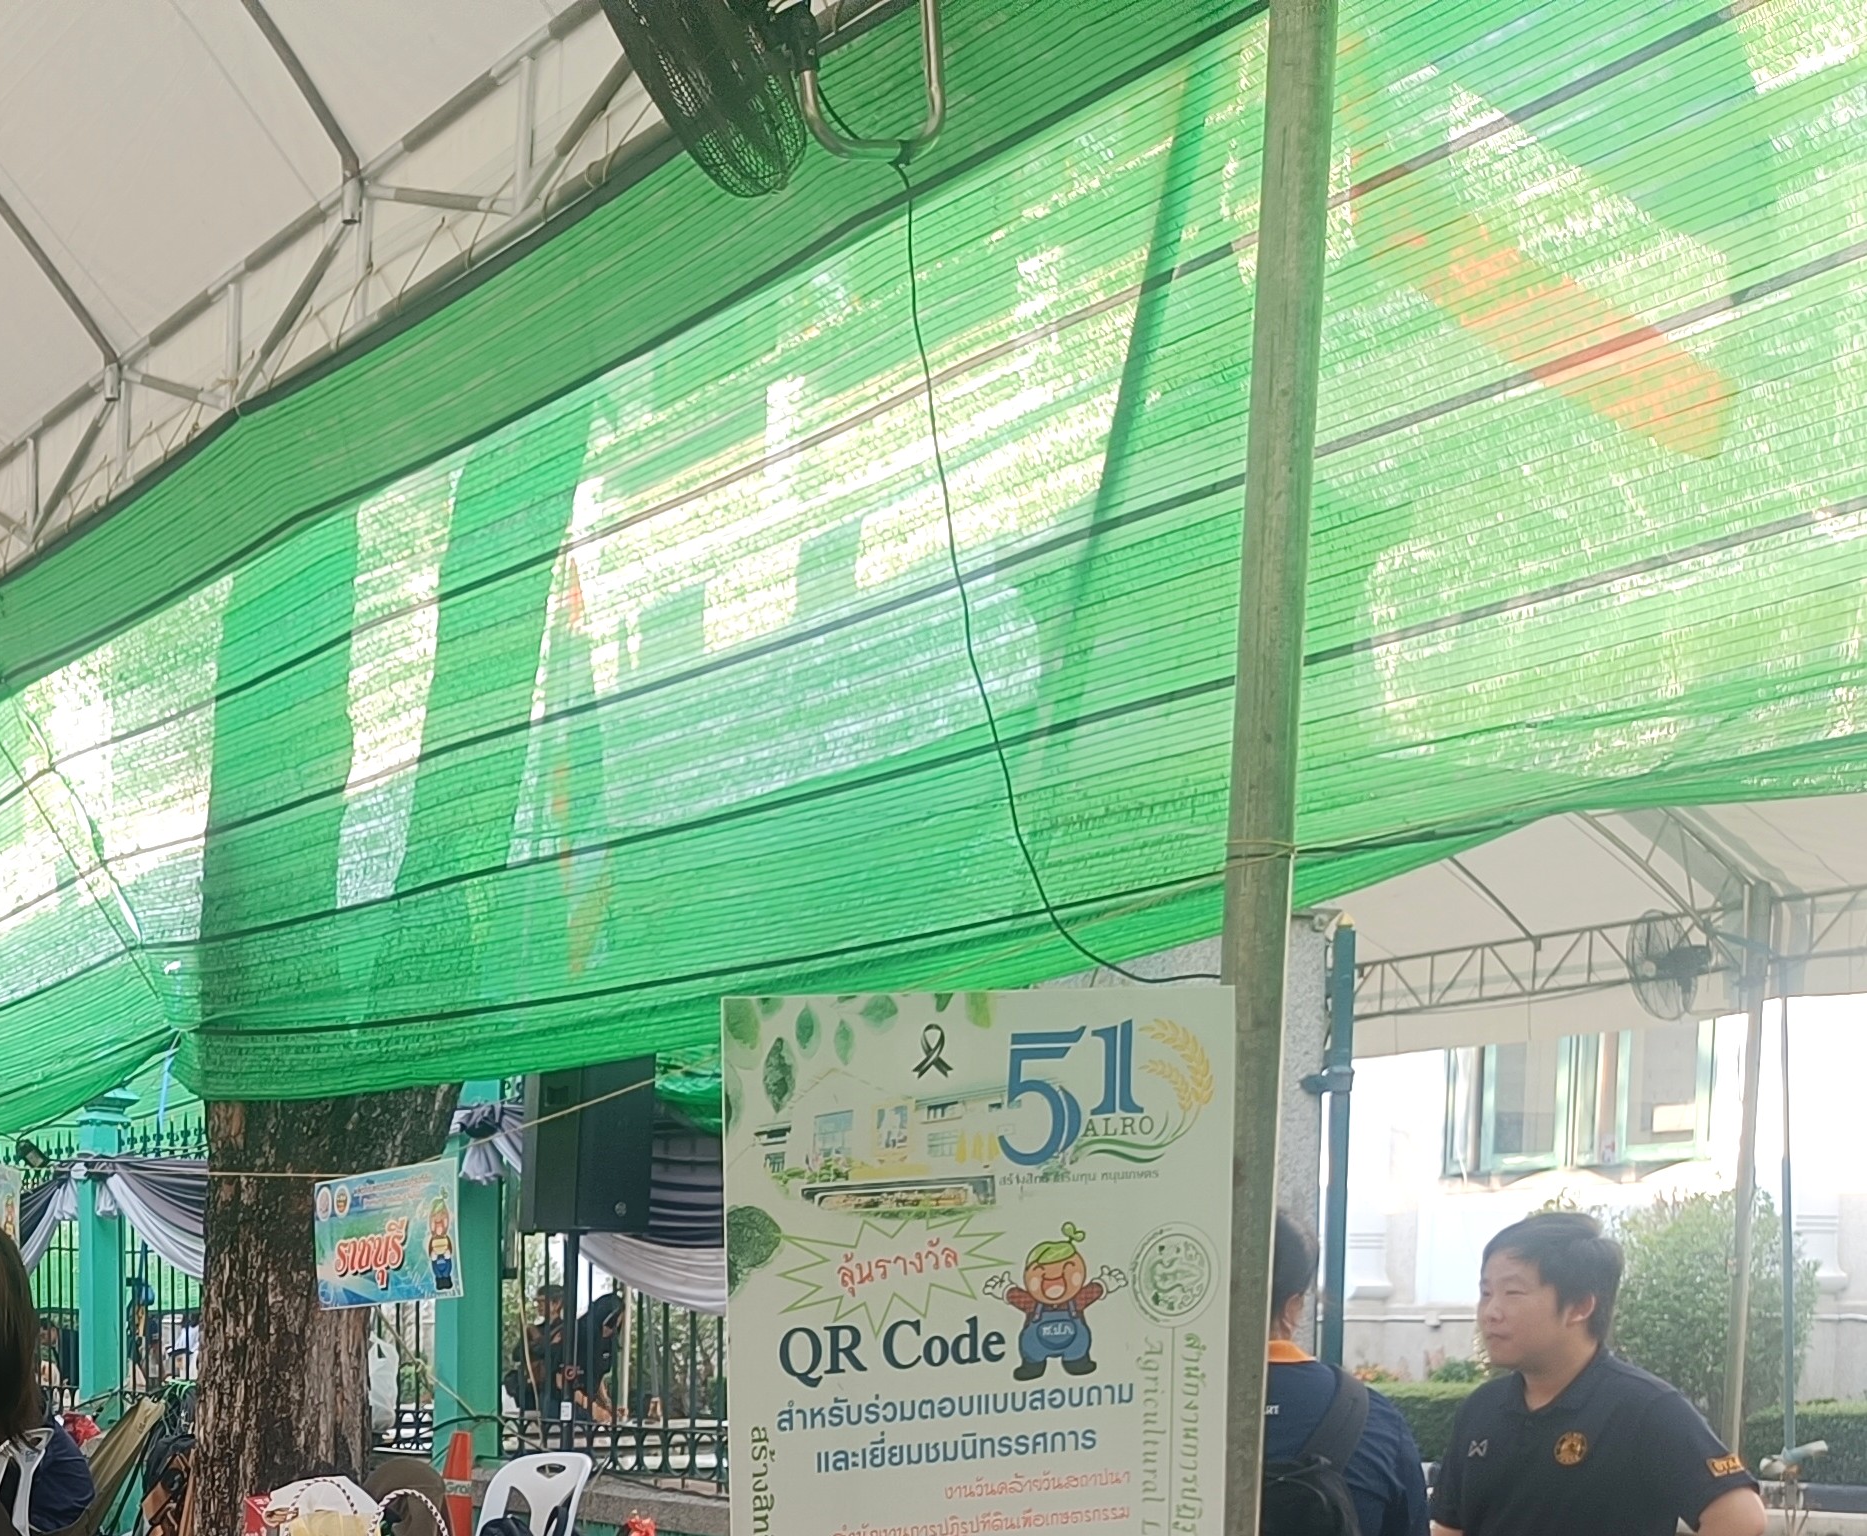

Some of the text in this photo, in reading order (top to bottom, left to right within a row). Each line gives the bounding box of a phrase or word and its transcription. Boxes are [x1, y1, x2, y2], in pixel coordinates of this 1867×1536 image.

[998, 1019, 1145, 1166] 51
[1081, 1114, 1154, 1138] ALRO
[335, 1217, 409, 1289] ราชบุรี
[837, 1237, 959, 1297] ลุ้นรางวัล
[779, 1315, 1006, 1388] QR Code
[776, 1382, 1134, 1433] สำหรับร่วมตอบแบบสอบถาม
[1136, 1336, 1167, 1503] Agricultural
[816, 1431, 1098, 1474] และเยี่ยมชมนิทรรศการ
[943, 1469, 1131, 1500] งานวันคล้ายวันสถาปนา
